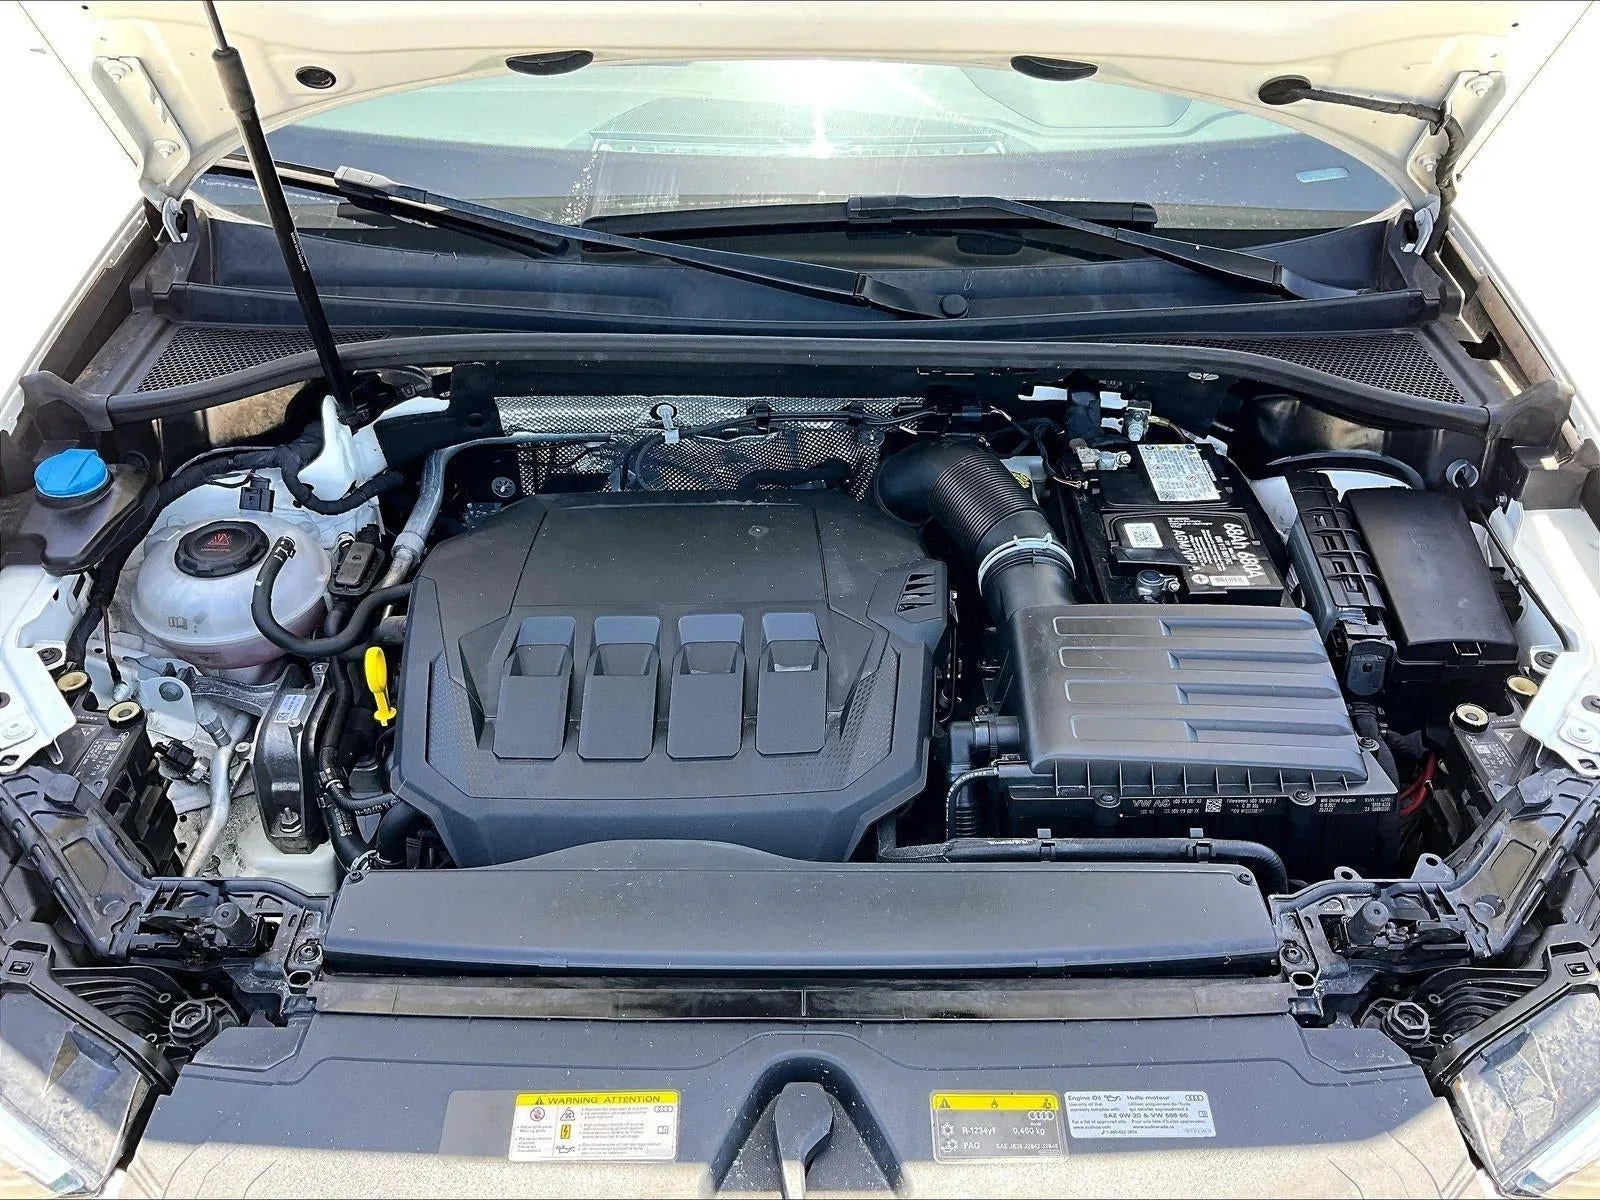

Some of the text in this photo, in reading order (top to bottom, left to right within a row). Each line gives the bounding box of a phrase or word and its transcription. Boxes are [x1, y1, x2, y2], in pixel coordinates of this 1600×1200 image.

[1223, 522, 1250, 550] 68Ah
[1236, 552, 1265, 578] 680A
[1153, 799, 1170, 807] AG
[604, 1095, 660, 1103] ATTENTION
[962, 1126, 996, 1136] R-1234yf
[1036, 1127, 1045, 1135] kg
